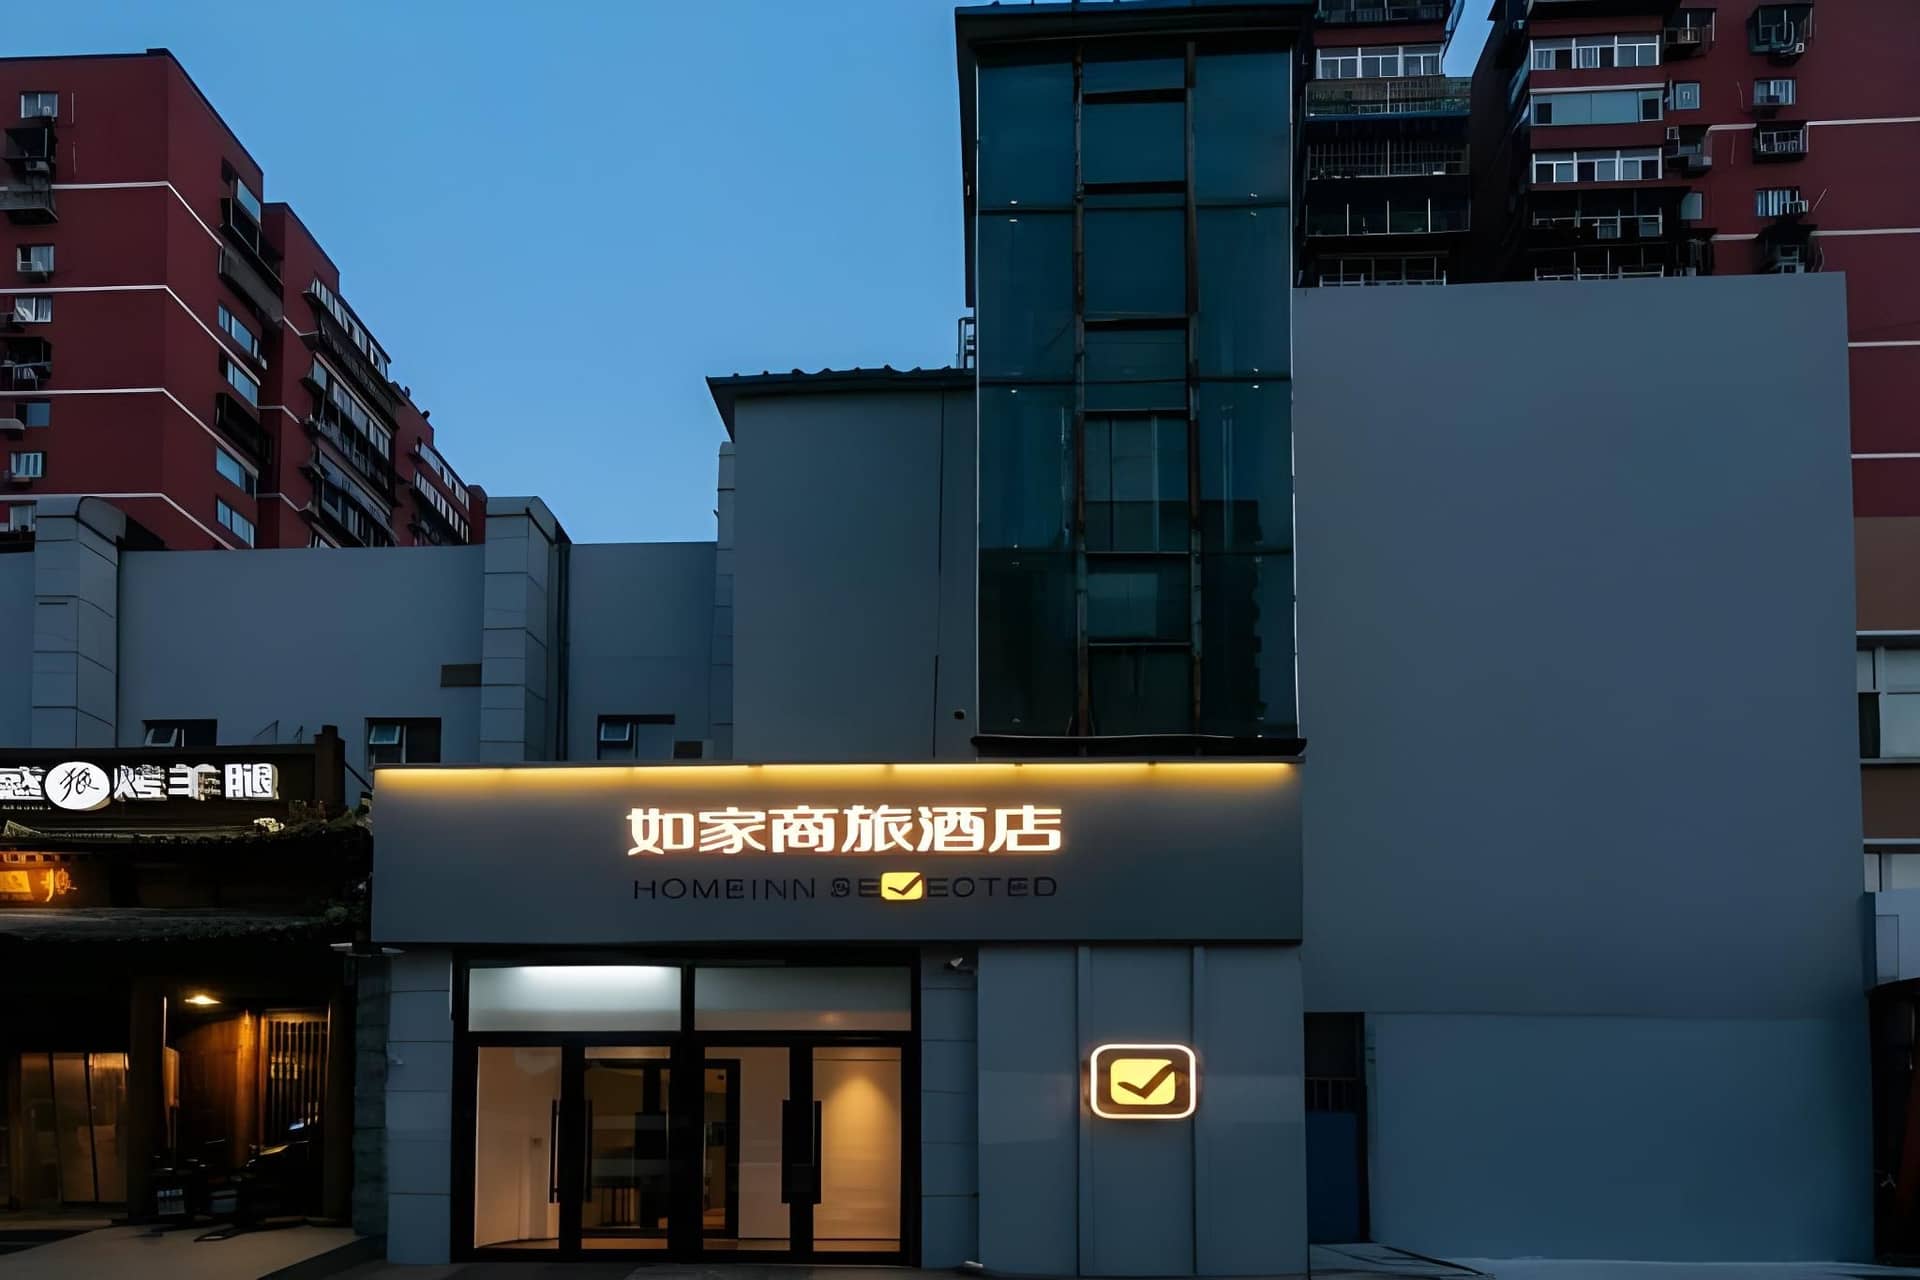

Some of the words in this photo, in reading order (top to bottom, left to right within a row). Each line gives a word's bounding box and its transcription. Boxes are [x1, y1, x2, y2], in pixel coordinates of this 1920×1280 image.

[626, 805, 1063, 856] 如家商旅酒店
